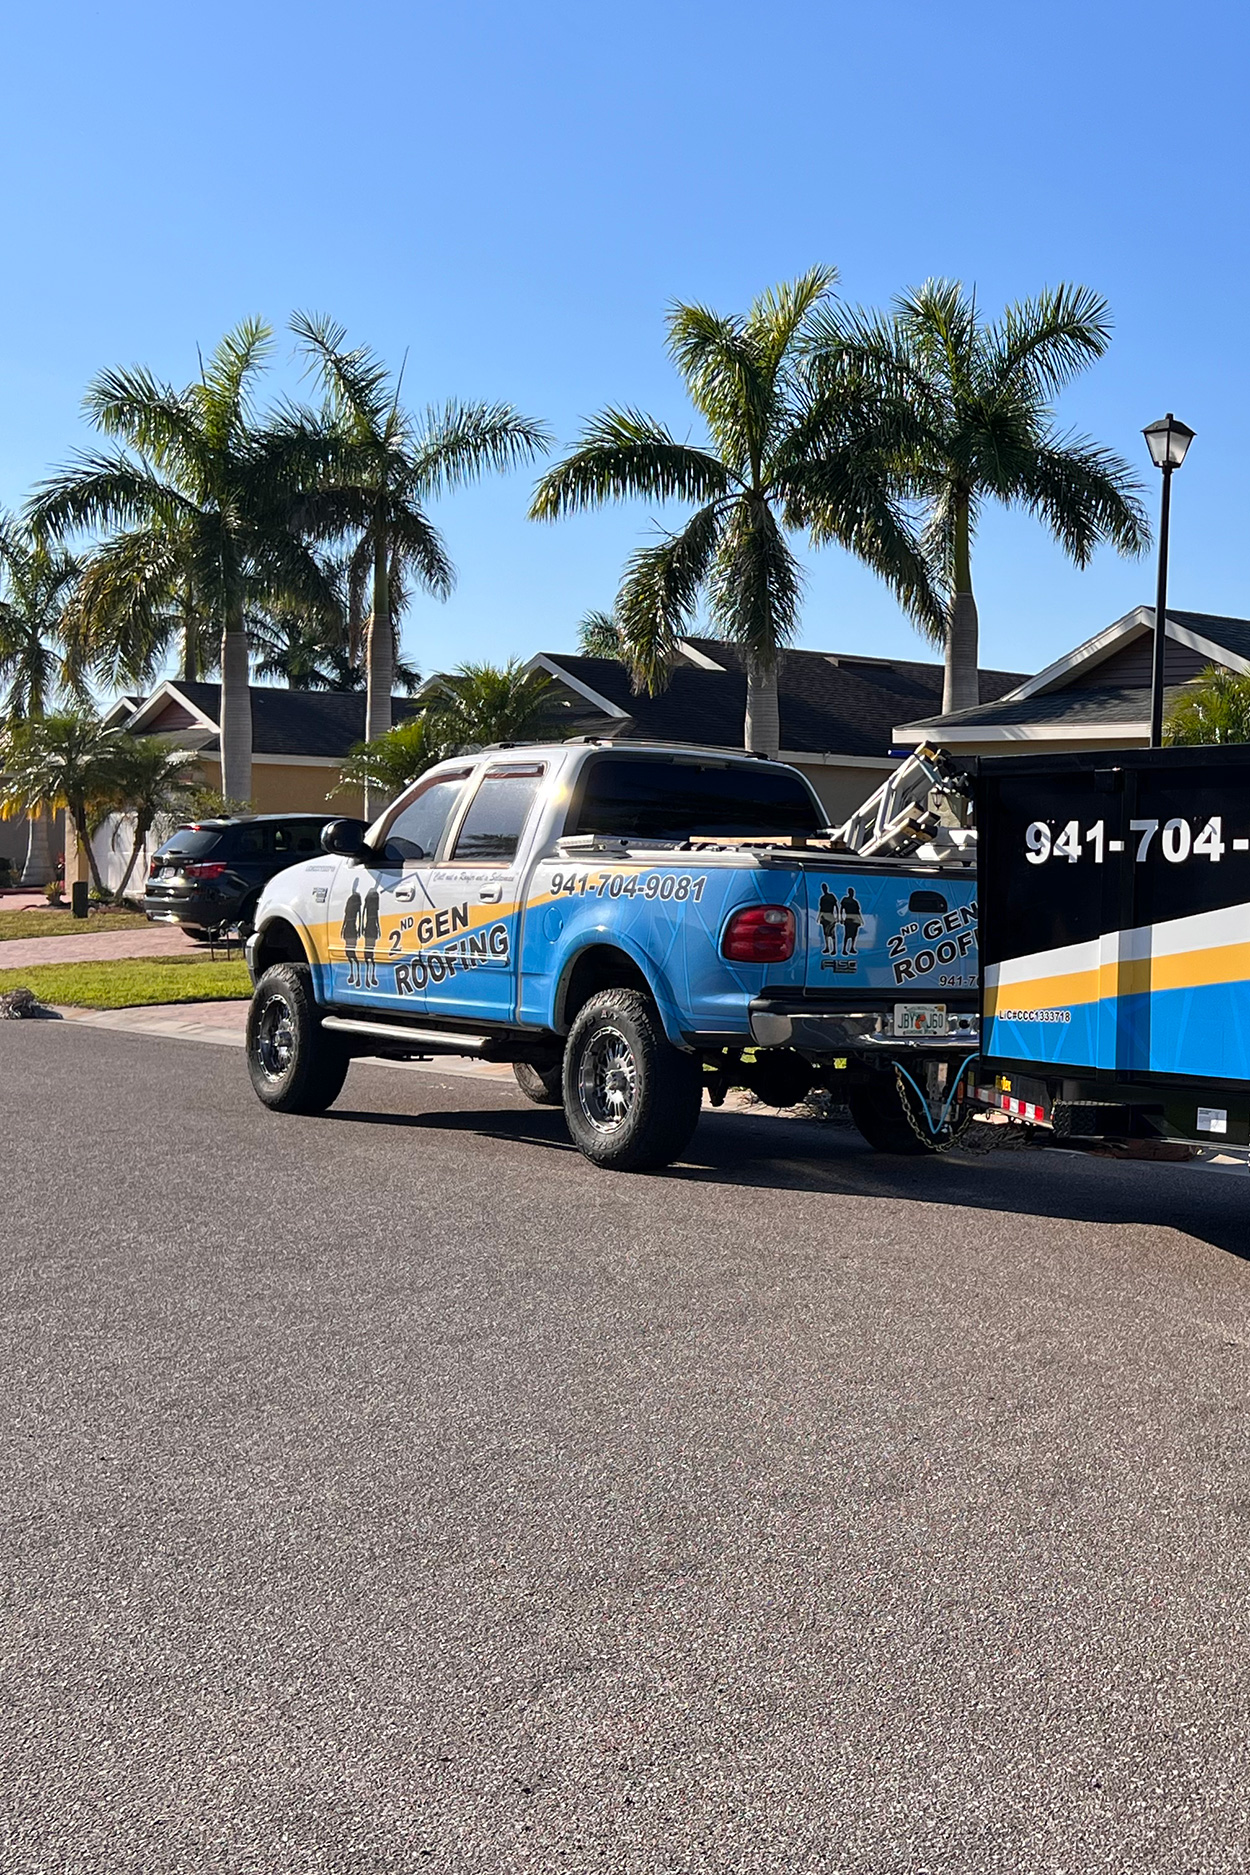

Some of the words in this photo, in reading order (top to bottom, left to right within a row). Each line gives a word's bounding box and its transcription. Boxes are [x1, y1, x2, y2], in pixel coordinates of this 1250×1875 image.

[549, 872, 706, 902] 941-704-9081
[417, 902, 469, 944] GEN
[922, 901, 979, 940] GEN
[394, 923, 509, 996] ROOFING
[892, 928, 979, 986] ROOF
